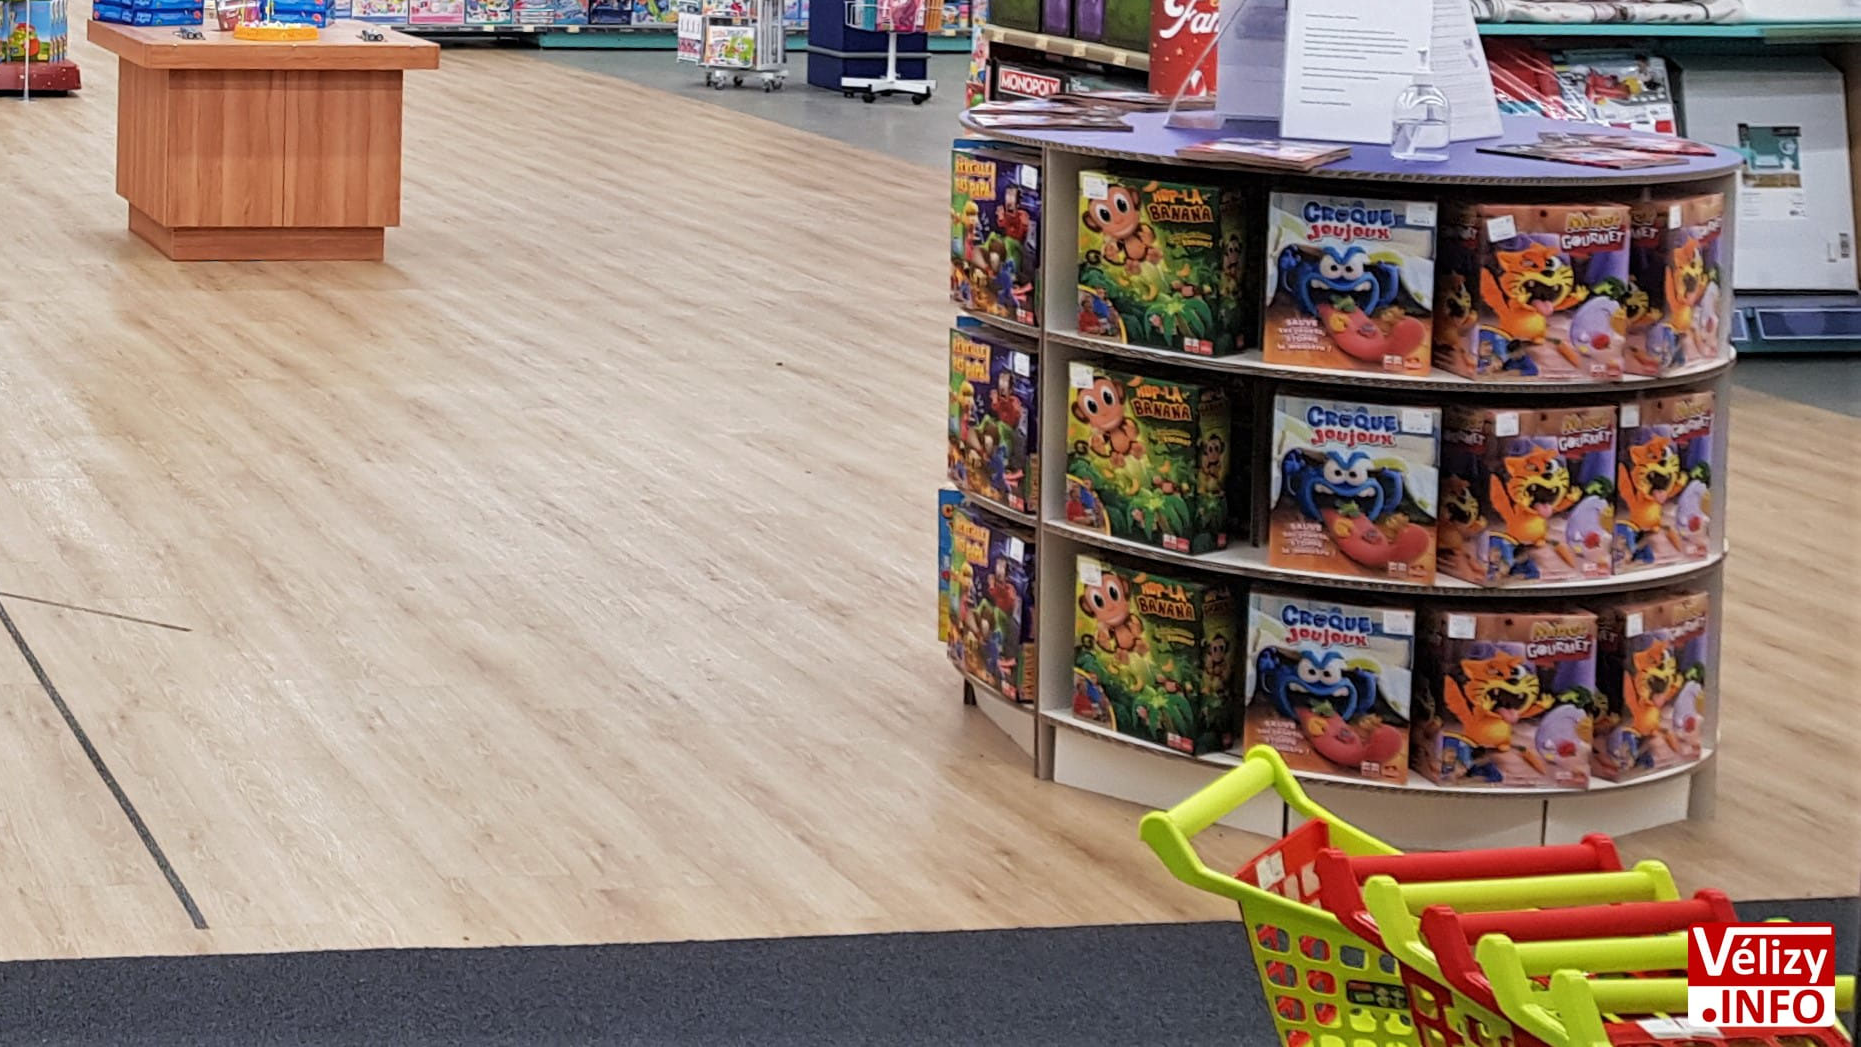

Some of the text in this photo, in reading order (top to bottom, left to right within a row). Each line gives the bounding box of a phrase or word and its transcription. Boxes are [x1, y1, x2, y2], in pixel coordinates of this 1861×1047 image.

[1001, 72, 1059, 96] MONOPOLY
[1148, 204, 1214, 223] BANANA
[1304, 201, 1395, 227] CROQUE
[1561, 229, 1625, 250] GOURMET
[1131, 399, 1193, 422] BANANA
[1307, 406, 1398, 432] CROQUE
[1558, 429, 1613, 452] GOURMET
[1138, 596, 1195, 621] BANANA
[1282, 605, 1372, 633] CROQUE
[1527, 639, 1591, 658] GOURMET
